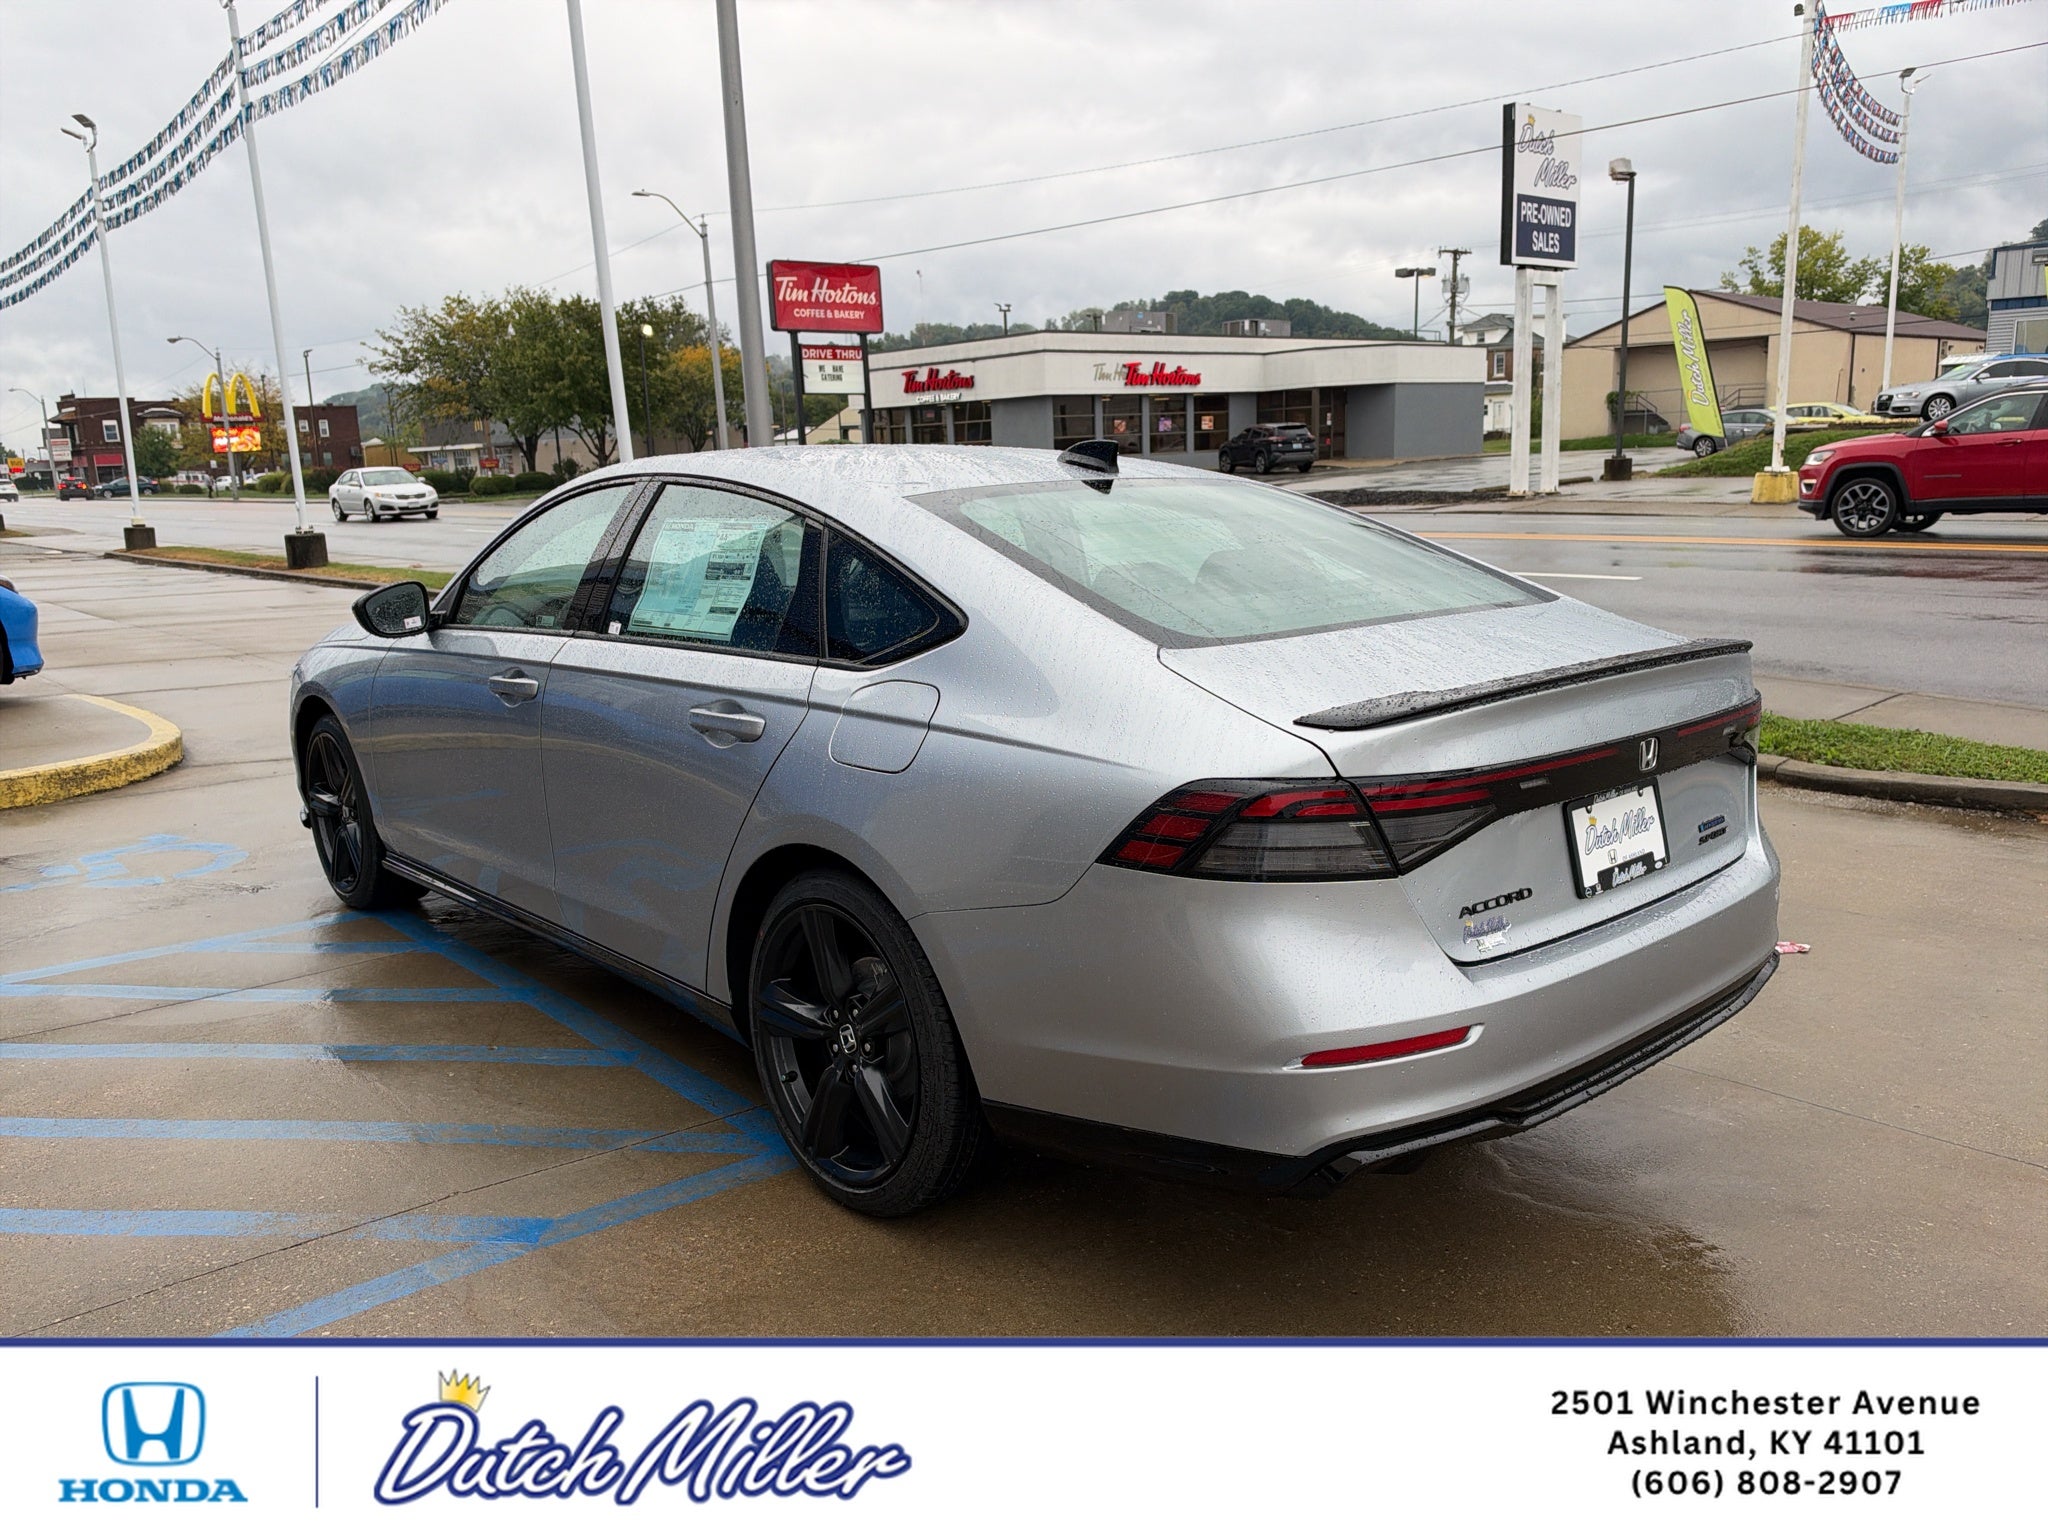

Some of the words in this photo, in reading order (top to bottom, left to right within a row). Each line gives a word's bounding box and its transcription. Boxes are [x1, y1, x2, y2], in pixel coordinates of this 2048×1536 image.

[1517, 122, 1555, 156] Dutch
[1533, 157, 1578, 190] Miller
[1520, 201, 1572, 228] PRE-OWNED
[1531, 230, 1560, 254] SALES
[775, 276, 808, 302] Tim
[810, 276, 877, 305] Hortons
[794, 308, 825, 319] COFFEE
[827, 310, 833, 319] &
[834, 310, 865, 320] BAKERY
[1676, 309, 1700, 362] Miller
[802, 349, 833, 359] DRIVE
[835, 349, 862, 360] THRU
[902, 370, 926, 394] Tim
[925, 367, 974, 391] Hortons
[1124, 362, 1150, 386] Tim
[1150, 361, 1201, 386] Hortons
[1686, 360, 1711, 407] Dutch
[1584, 817, 1620, 856] Dutch
[1619, 806, 1656, 844] Miller
[1458, 887, 1533, 919] ACCORD
